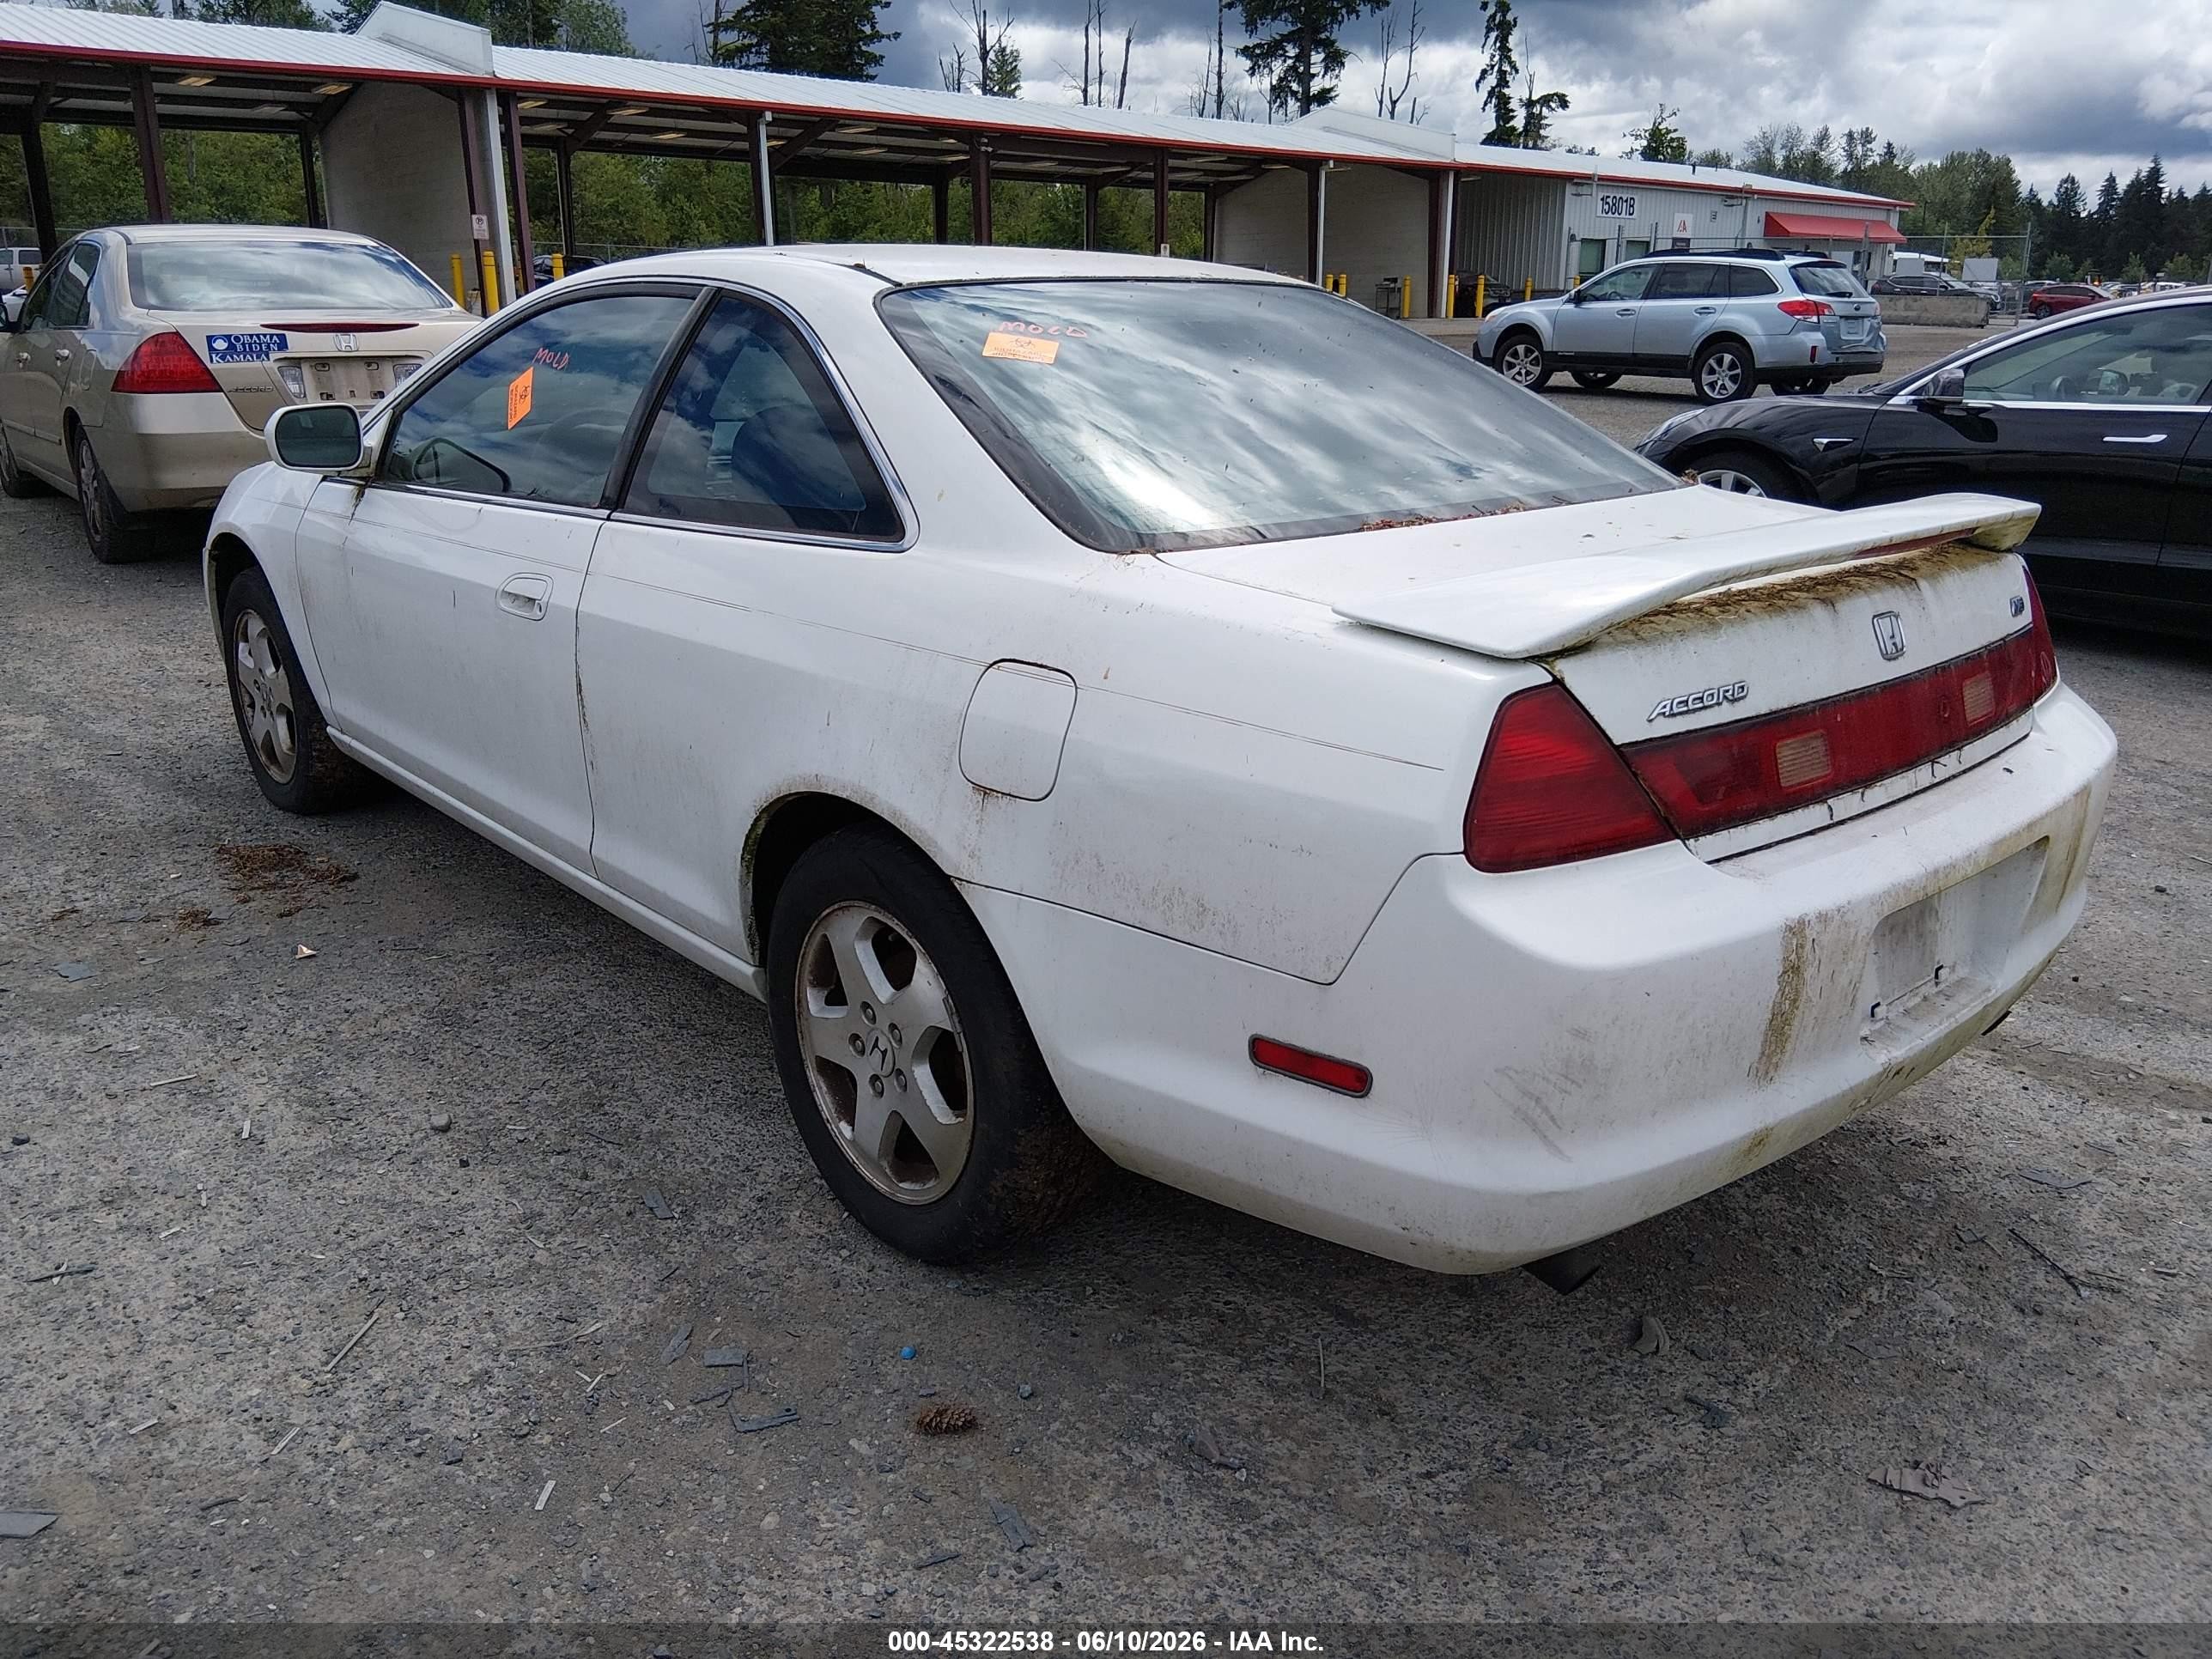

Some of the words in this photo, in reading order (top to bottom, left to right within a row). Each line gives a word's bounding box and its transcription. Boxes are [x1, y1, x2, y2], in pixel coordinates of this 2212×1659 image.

[1600, 195, 1636, 216] 15801B
[1000, 320, 1087, 337] MOLD
[231, 334, 280, 344] OBAMA
[236, 343, 278, 352] BIDEN
[211, 353, 268, 363] KAMALA
[532, 348, 569, 370] MOLD
[1646, 681, 1748, 723] ACCORD
